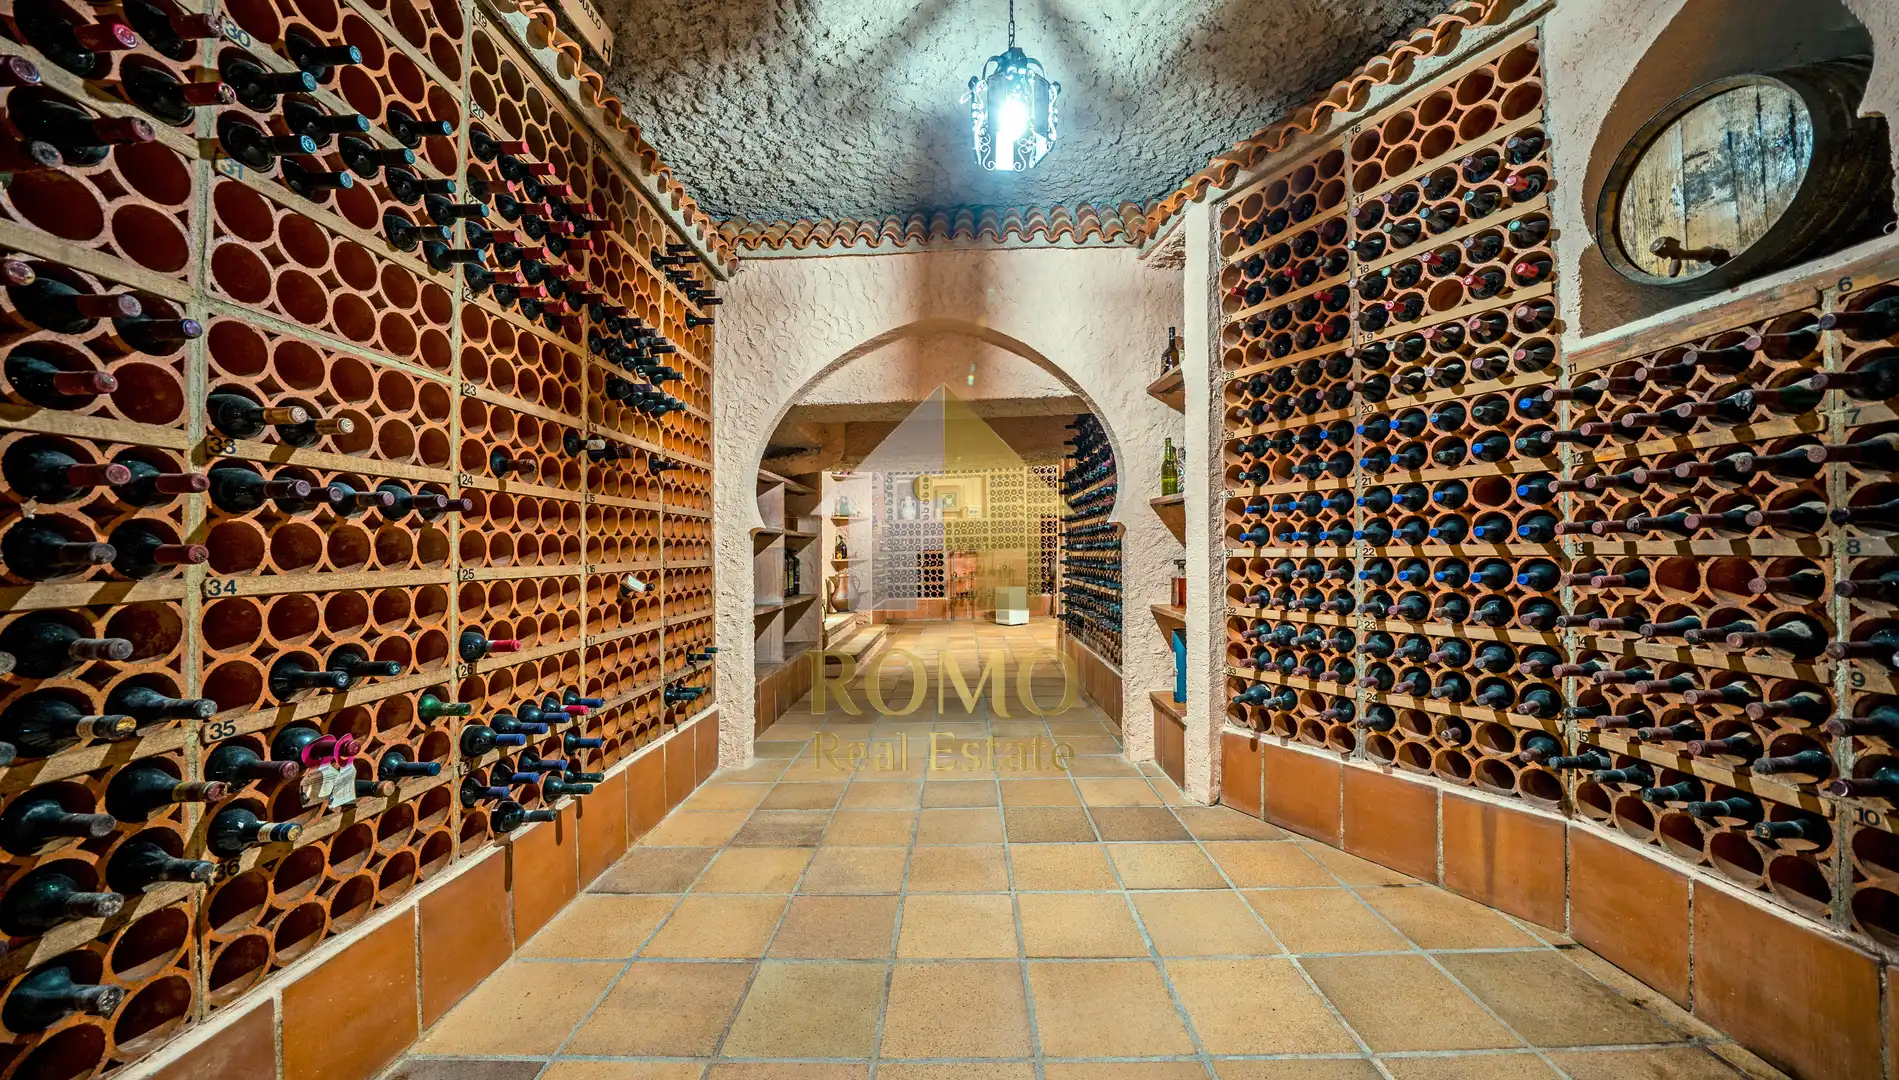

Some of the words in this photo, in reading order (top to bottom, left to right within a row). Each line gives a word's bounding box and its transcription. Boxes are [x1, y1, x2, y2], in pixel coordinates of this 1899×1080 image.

[224, 20, 251, 48] 30
[602, 39, 611, 62] H
[472, 103, 484, 120] 20
[1351, 125, 1361, 135] 16
[221, 157, 243, 180] 31
[1354, 193, 1365, 203] 17
[1358, 264, 1369, 275] 18
[1838, 276, 1853, 292] 6
[465, 288, 478, 303] 22
[1361, 333, 1373, 343] 19
[1567, 362, 1577, 373] 11
[1225, 371, 1235, 379] 28
[464, 383, 477, 396] 23
[1361, 404, 1374, 413] 20
[1847, 408, 1861, 424] 7
[209, 436, 237, 455] 33
[1571, 452, 1584, 464] 12
[462, 474, 474, 486] 24
[1361, 477, 1372, 486] 21
[1362, 547, 1375, 556] 22
[1573, 542, 1584, 553] 13
[1846, 539, 1861, 554] 8
[462, 568, 475, 580] 25
[207, 578, 238, 596] 34
[1364, 620, 1376, 630] 23
[1576, 635, 1588, 646] 14
[460, 663, 473, 677] 26
[1851, 671, 1865, 687] 9
[1366, 692, 1379, 703] 24
[209, 719, 236, 740] 35
[1578, 730, 1589, 742] 15
[1854, 807, 1880, 826] 10
[214, 859, 240, 883] 36
